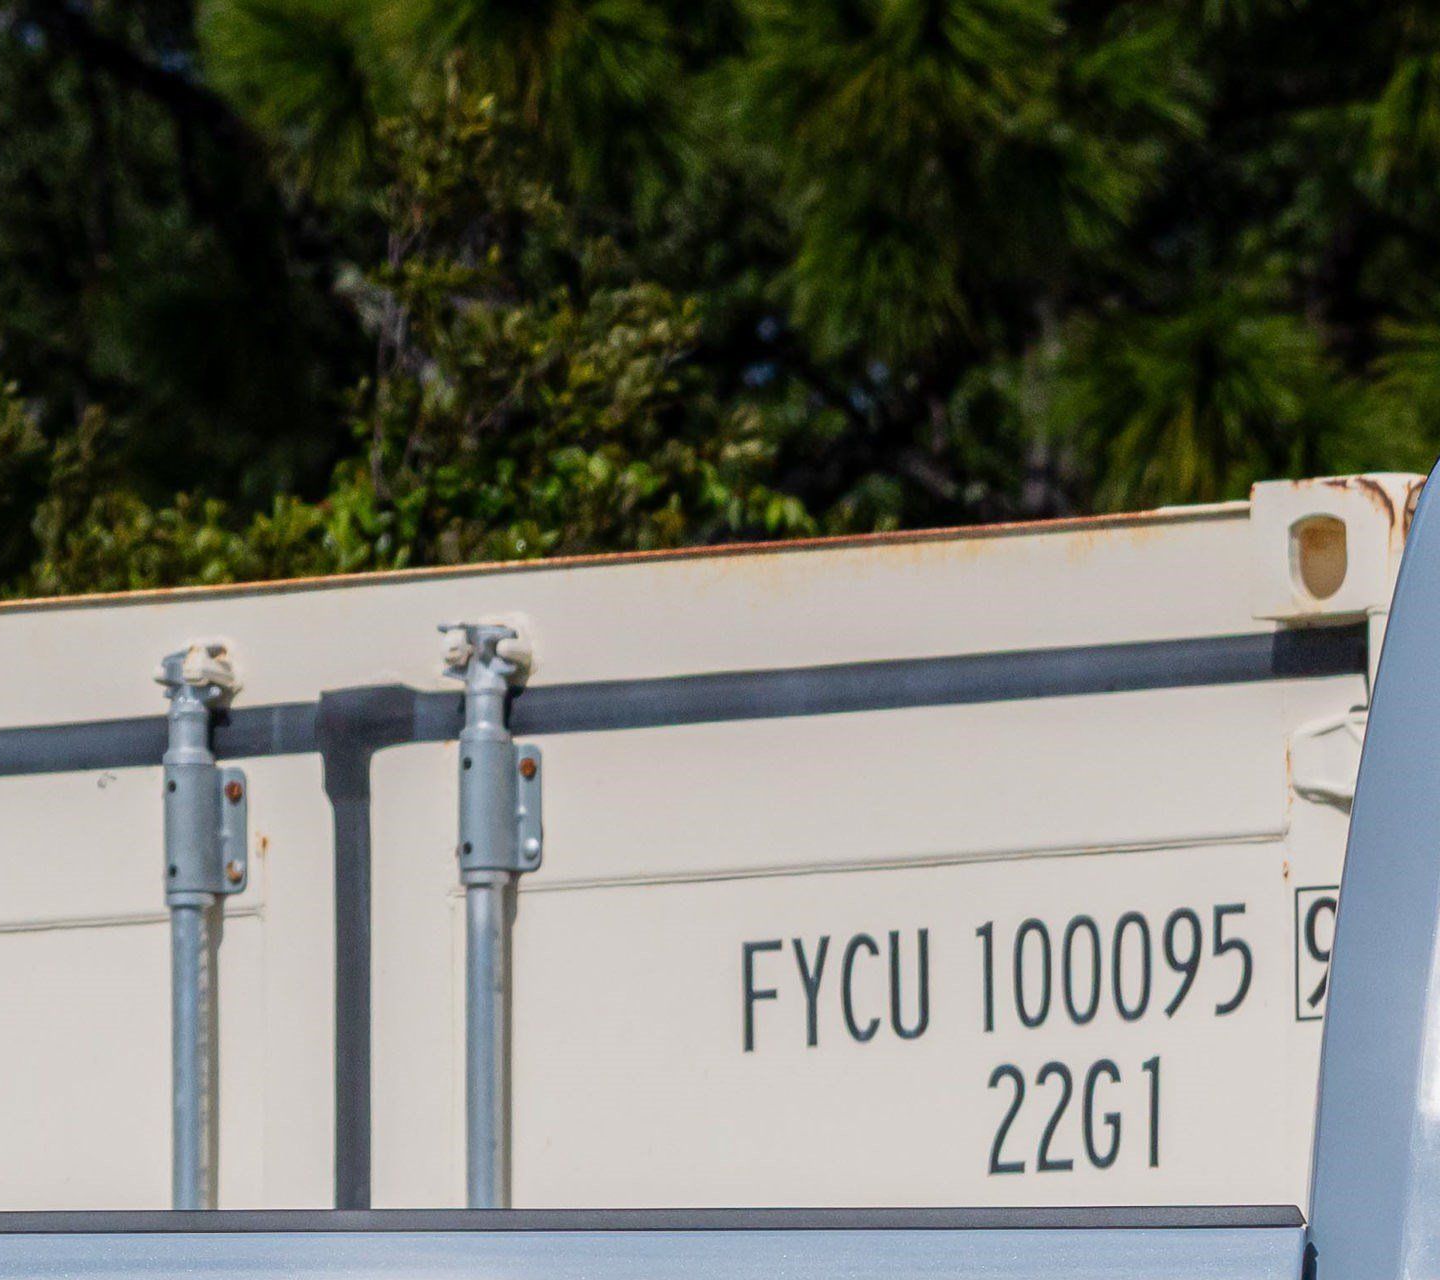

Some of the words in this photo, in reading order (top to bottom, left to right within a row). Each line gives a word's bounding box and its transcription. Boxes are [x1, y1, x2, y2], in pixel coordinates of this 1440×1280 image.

[740, 927, 931, 1053] FYCU
[975, 902, 1255, 1035] 100095
[1304, 896, 1338, 1009] 9
[987, 1055, 1162, 1177] 22G1
